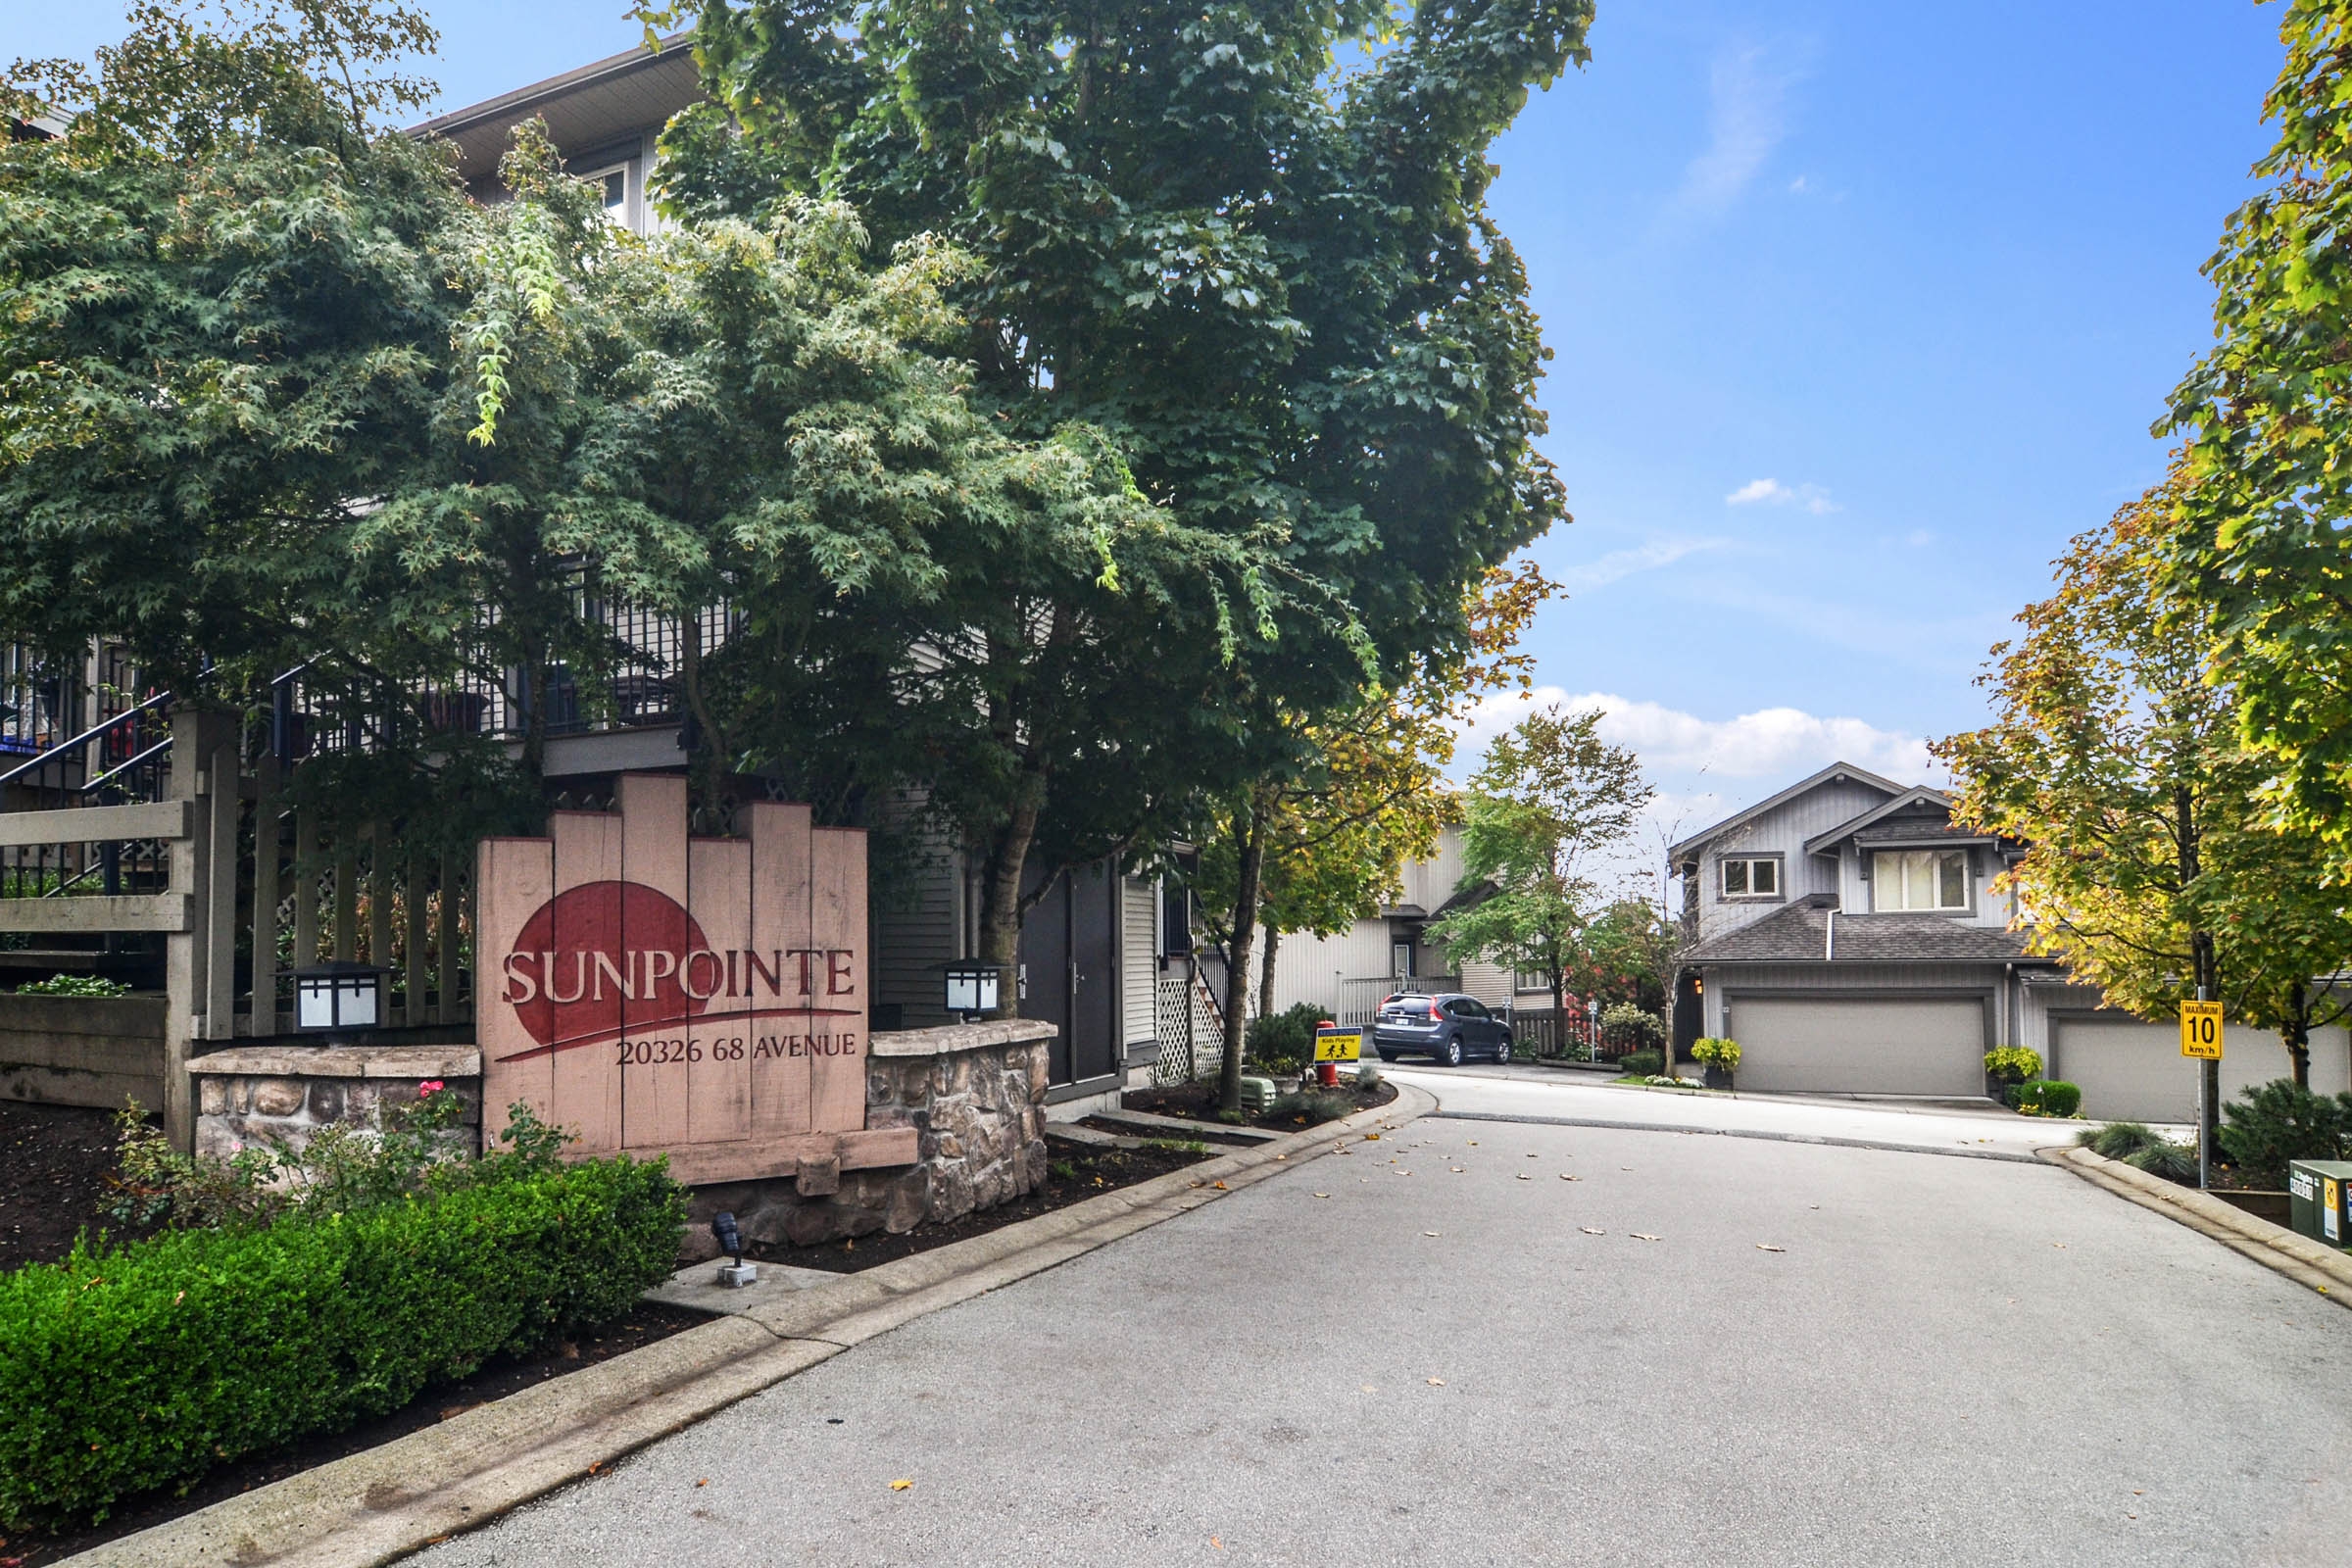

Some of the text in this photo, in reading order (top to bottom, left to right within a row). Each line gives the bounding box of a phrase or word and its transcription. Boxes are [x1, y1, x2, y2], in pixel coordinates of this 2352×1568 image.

[502, 949, 855, 1004] SUNPOINTE
[2185, 1005, 2218, 1014] MAXIMUM
[2188, 1016, 2215, 1044] 10
[615, 1033, 857, 1065] 20326 68 AVENUE
[2189, 1045, 2215, 1054] km/h
